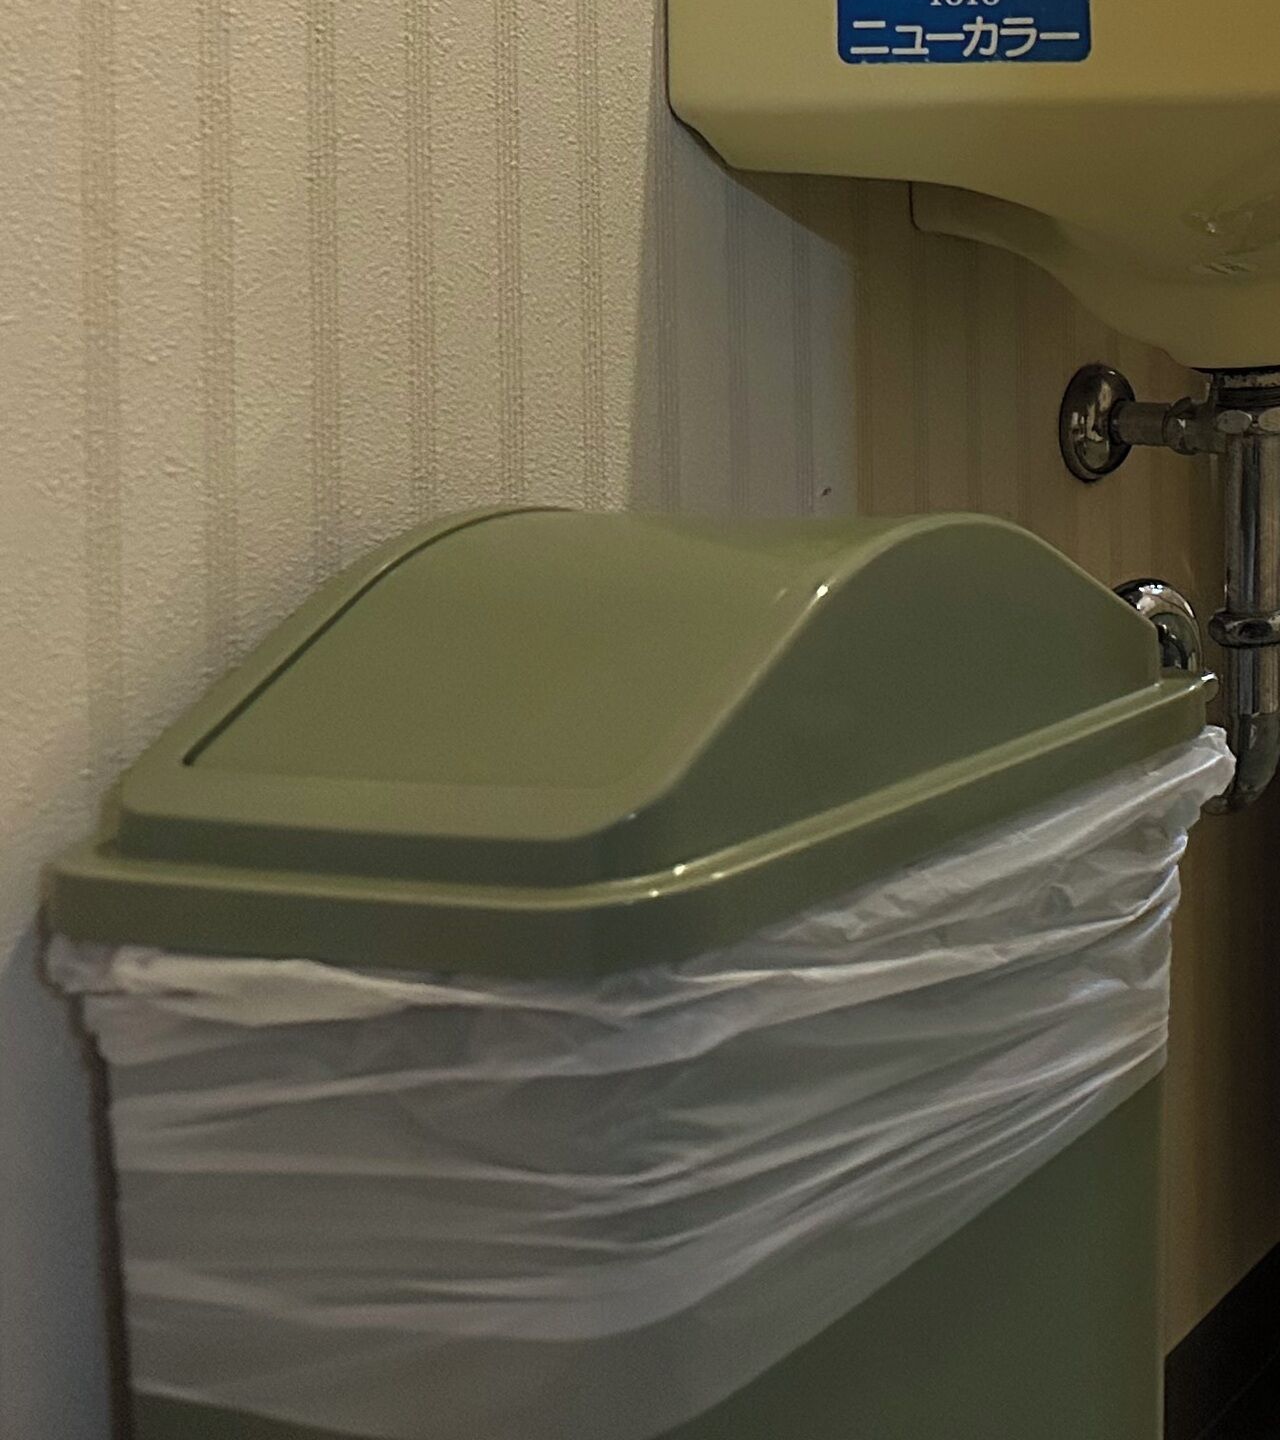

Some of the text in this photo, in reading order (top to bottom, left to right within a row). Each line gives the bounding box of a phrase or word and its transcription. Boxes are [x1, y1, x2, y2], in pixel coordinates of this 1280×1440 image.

[850, 15, 1080, 57] ニューカラー
